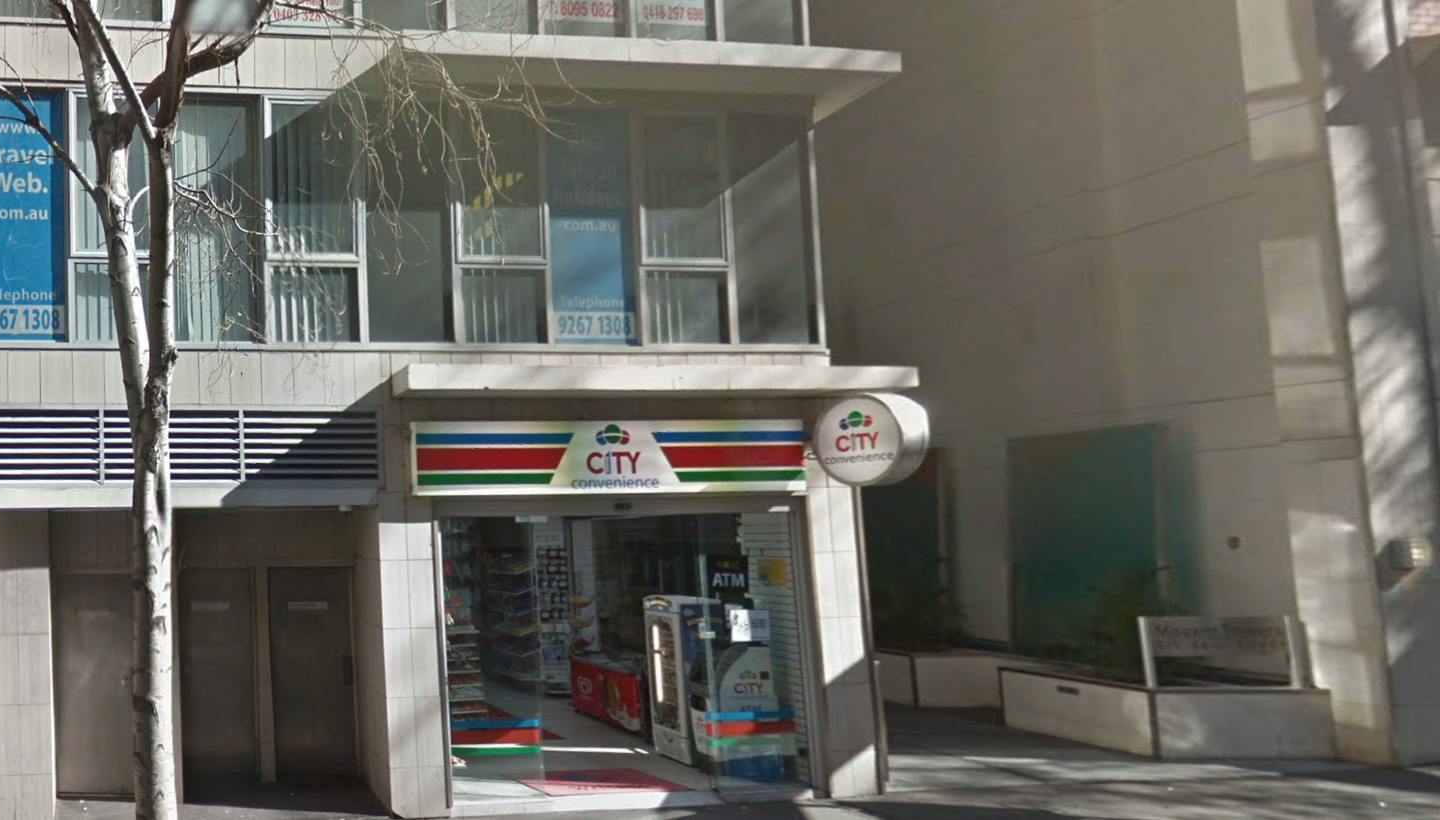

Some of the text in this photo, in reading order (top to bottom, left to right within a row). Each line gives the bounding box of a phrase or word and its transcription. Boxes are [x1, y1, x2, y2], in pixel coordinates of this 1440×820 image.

[561, 1, 588, 17] 8095
[591, 2, 619, 18] 0822
[563, 219, 616, 231] com.au
[23, 308, 60, 330] 1308
[558, 314, 631, 336] 9267 1308
[586, 450, 641, 474] CITY
[824, 452, 894, 466] convenience
[571, 476, 660, 489] convenience
[712, 572, 745, 588] ATM
[733, 682, 763, 694] CITY
